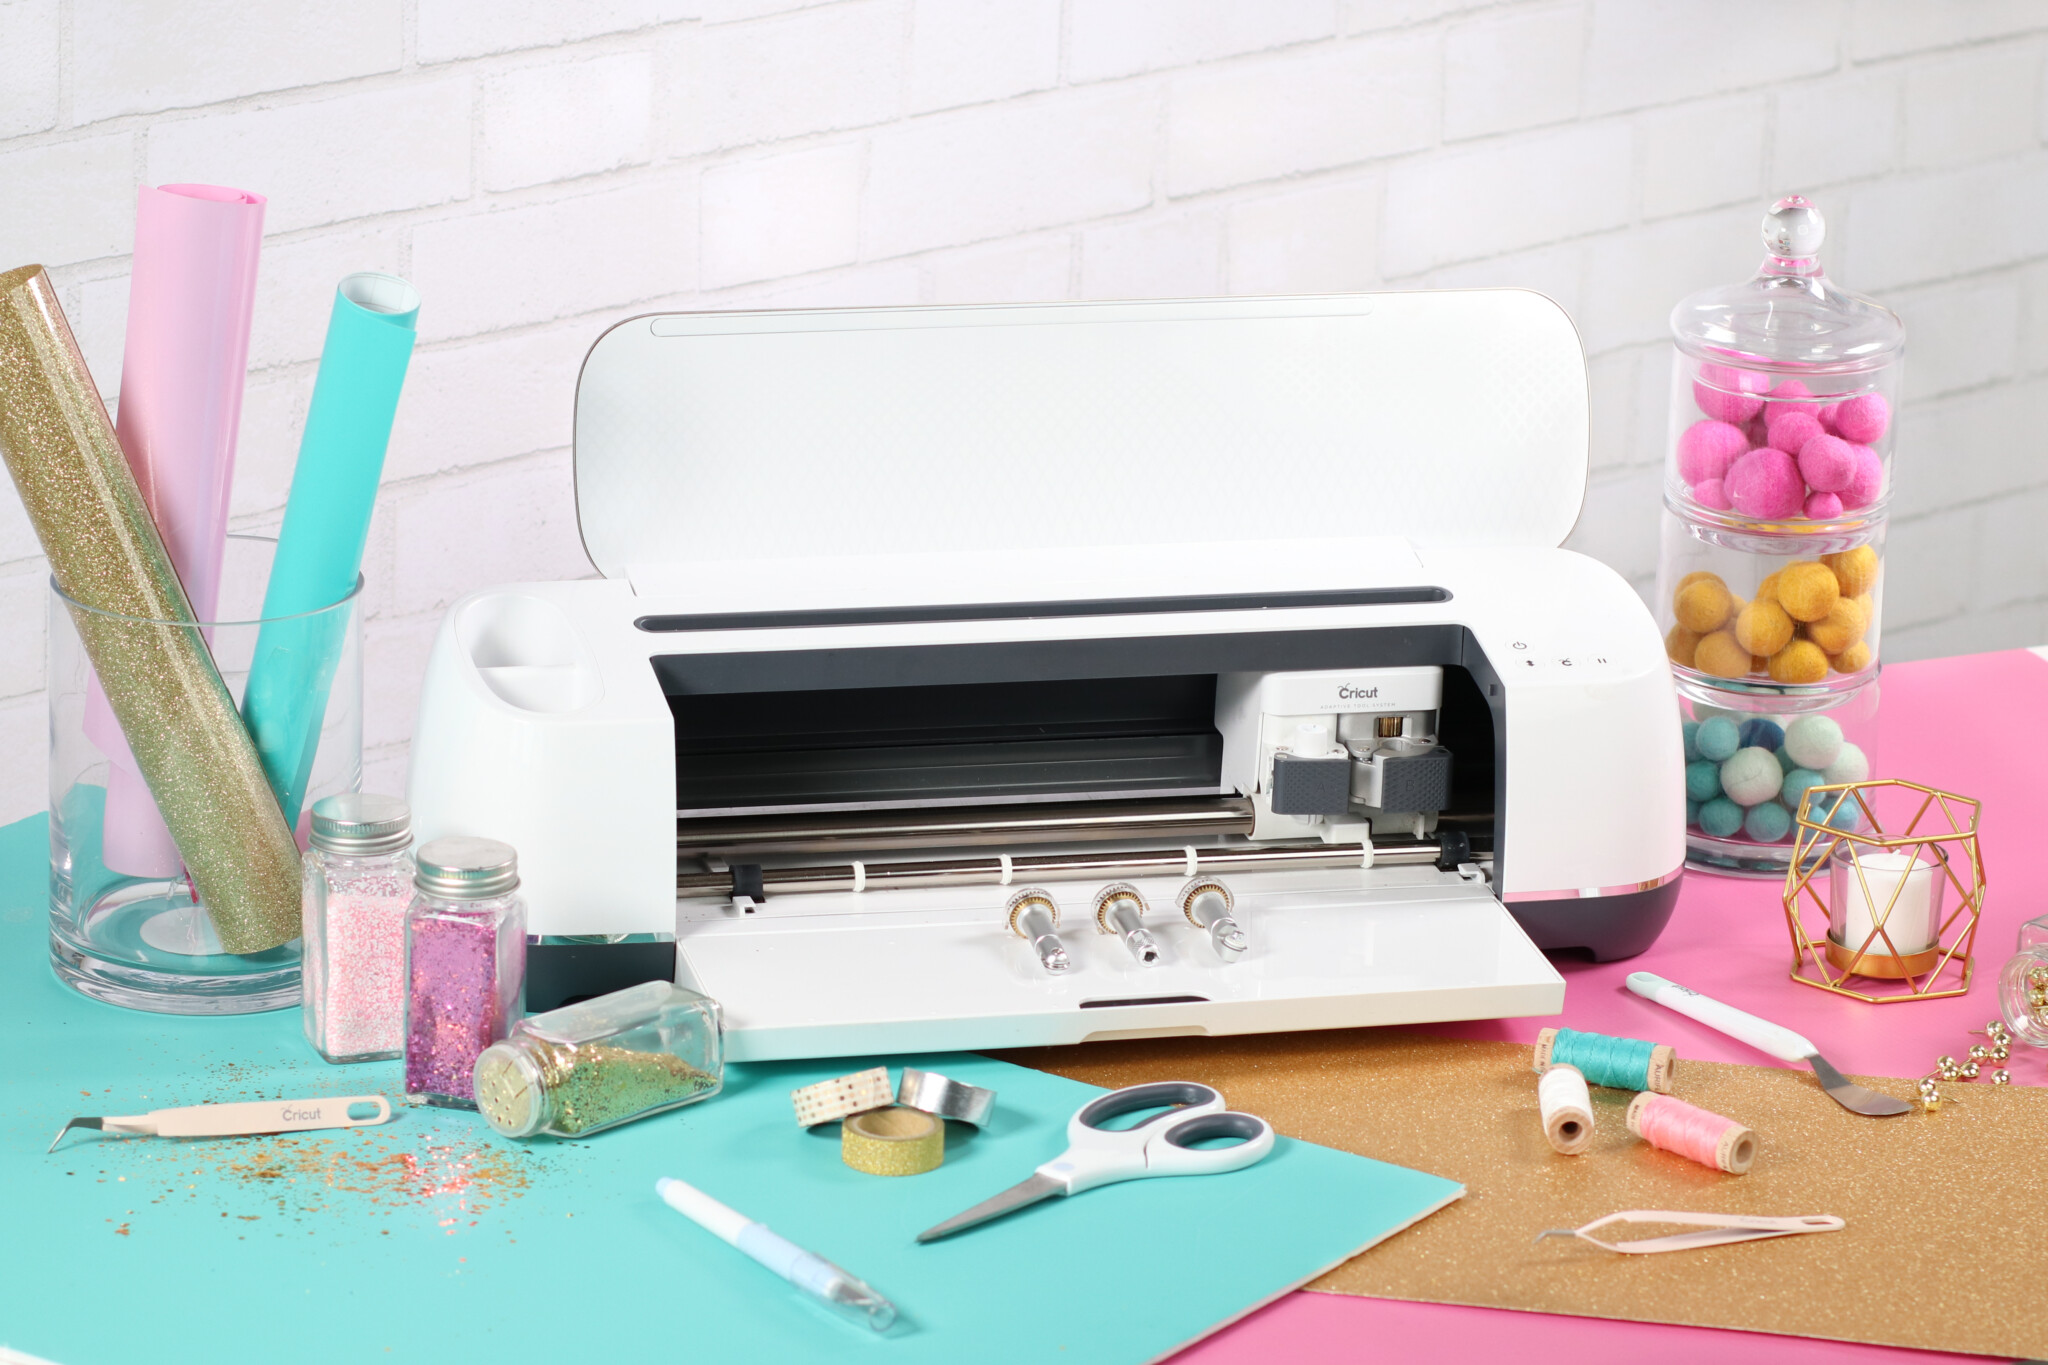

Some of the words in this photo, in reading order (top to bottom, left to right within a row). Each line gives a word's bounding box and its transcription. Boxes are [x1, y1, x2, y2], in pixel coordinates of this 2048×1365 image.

[1337, 683, 1378, 699] Cricut
[1315, 782, 1326, 793] A
[1405, 780, 1415, 792] B
[281, 1104, 321, 1122] Cricut
